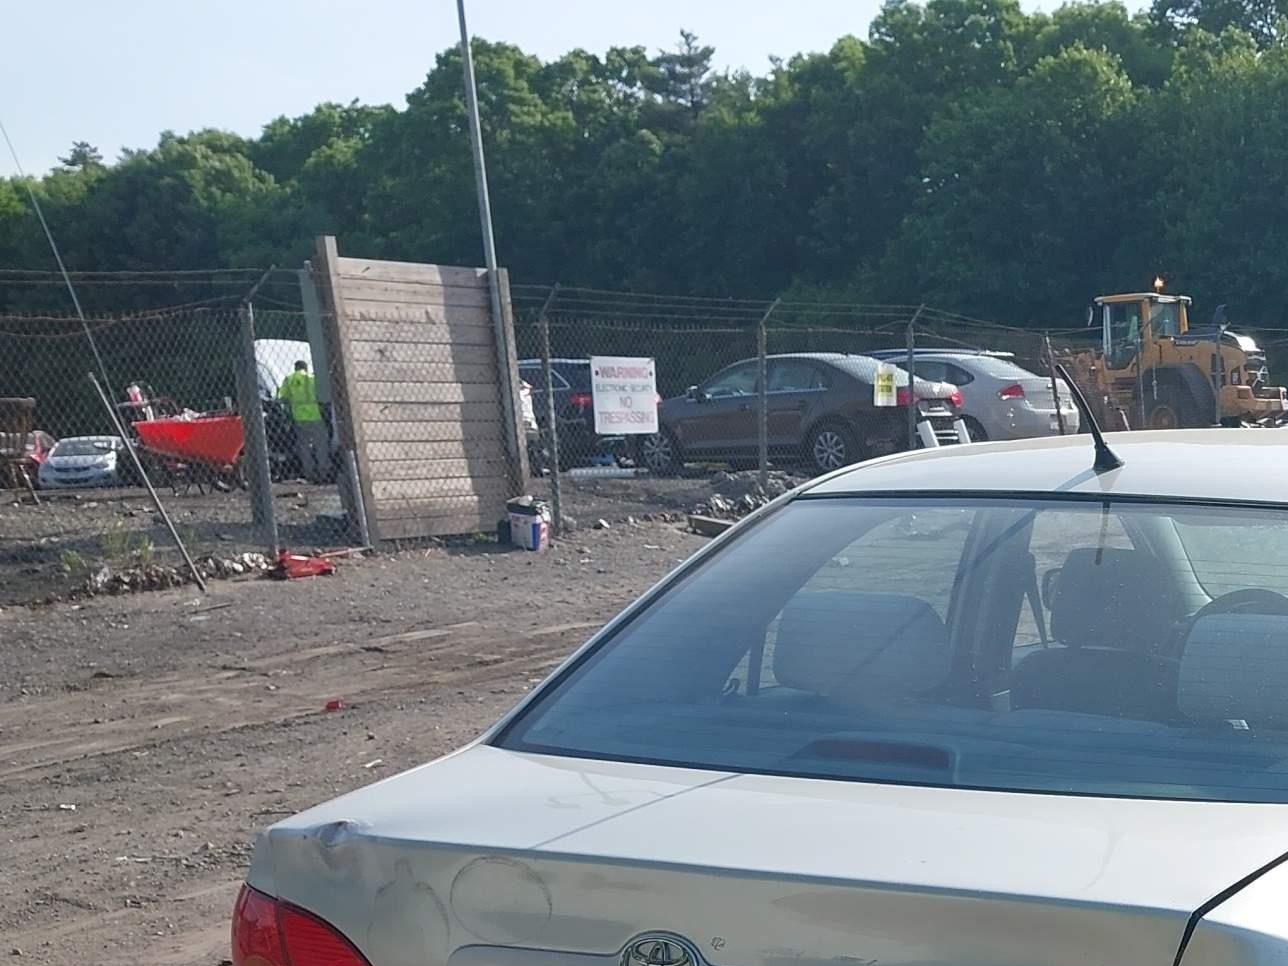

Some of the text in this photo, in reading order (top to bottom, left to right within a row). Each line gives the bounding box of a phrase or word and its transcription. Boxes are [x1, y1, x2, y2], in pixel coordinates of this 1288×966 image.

[598, 366, 649, 379] WARNING
[619, 396, 633, 409] NO
[598, 410, 655, 425] TRESPASSING
